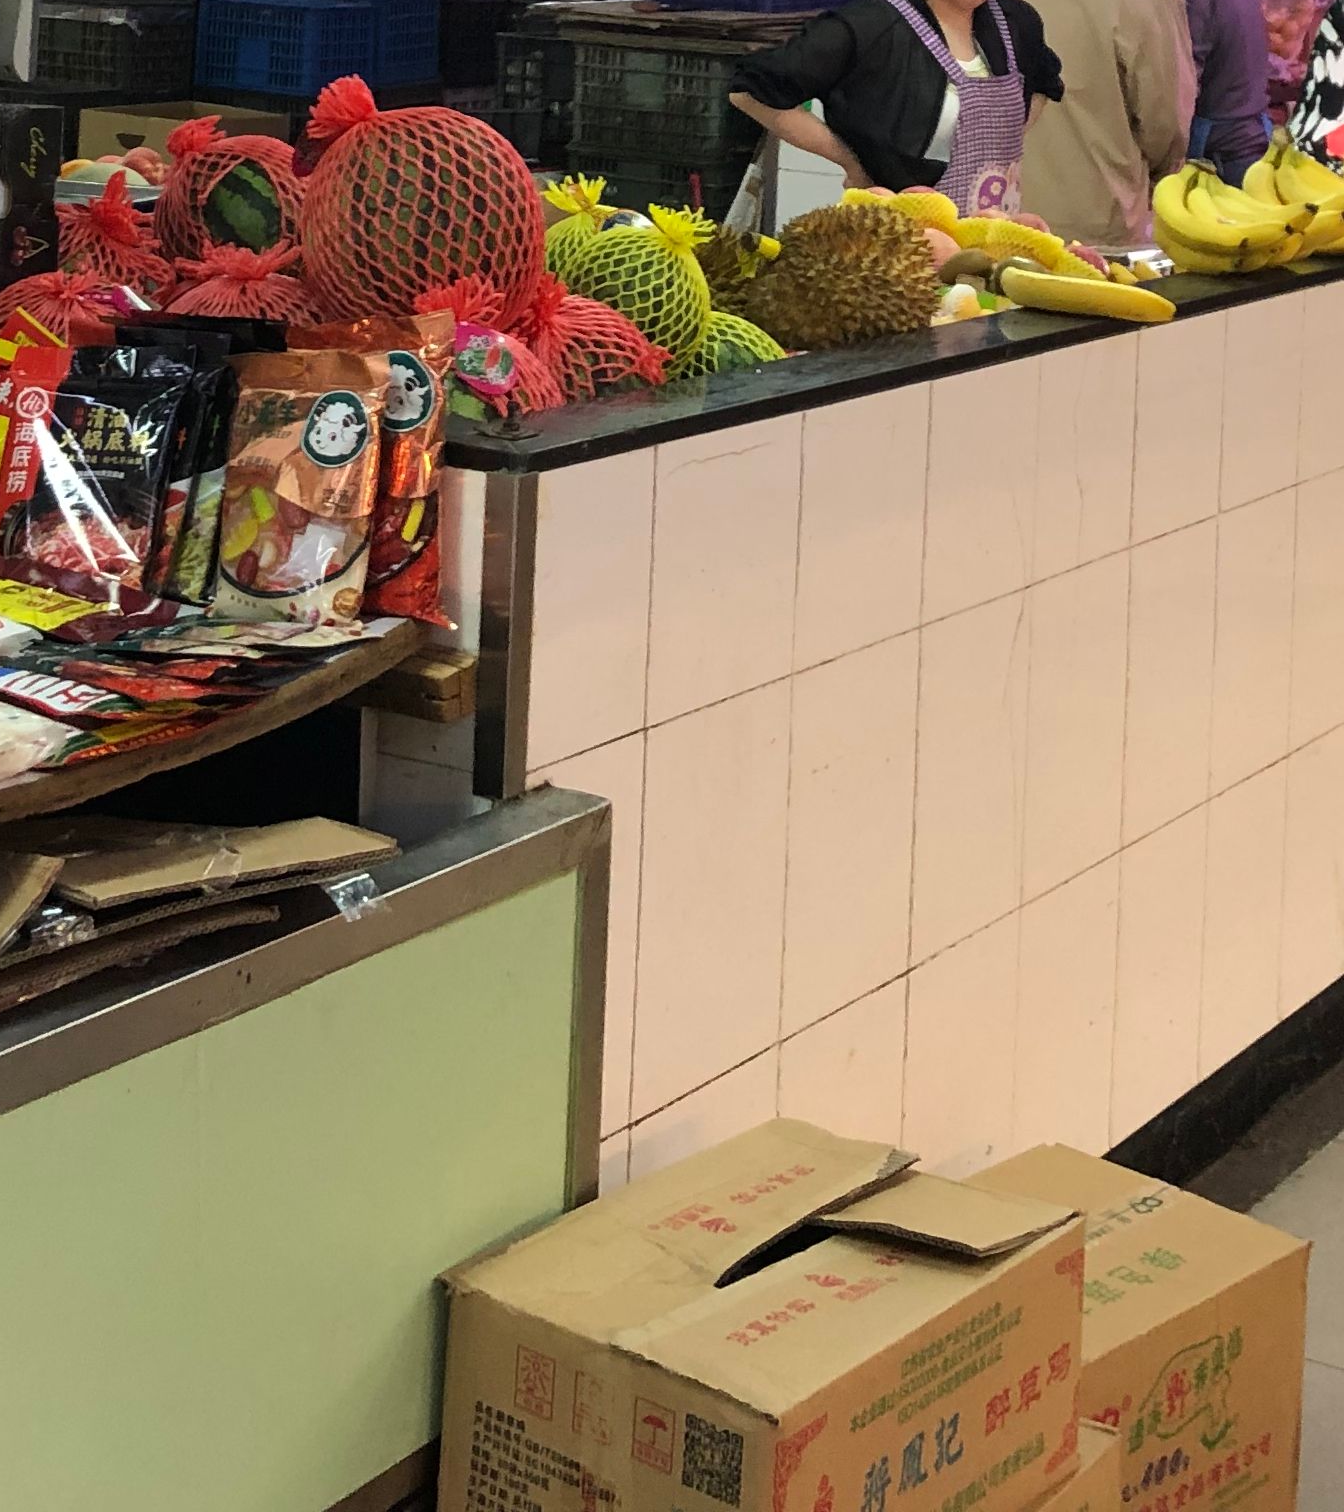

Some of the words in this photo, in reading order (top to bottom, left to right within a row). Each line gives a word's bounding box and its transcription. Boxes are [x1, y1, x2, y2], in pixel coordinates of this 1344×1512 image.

[87, 406, 128, 429] 清油
[5, 421, 36, 495] 海底捞
